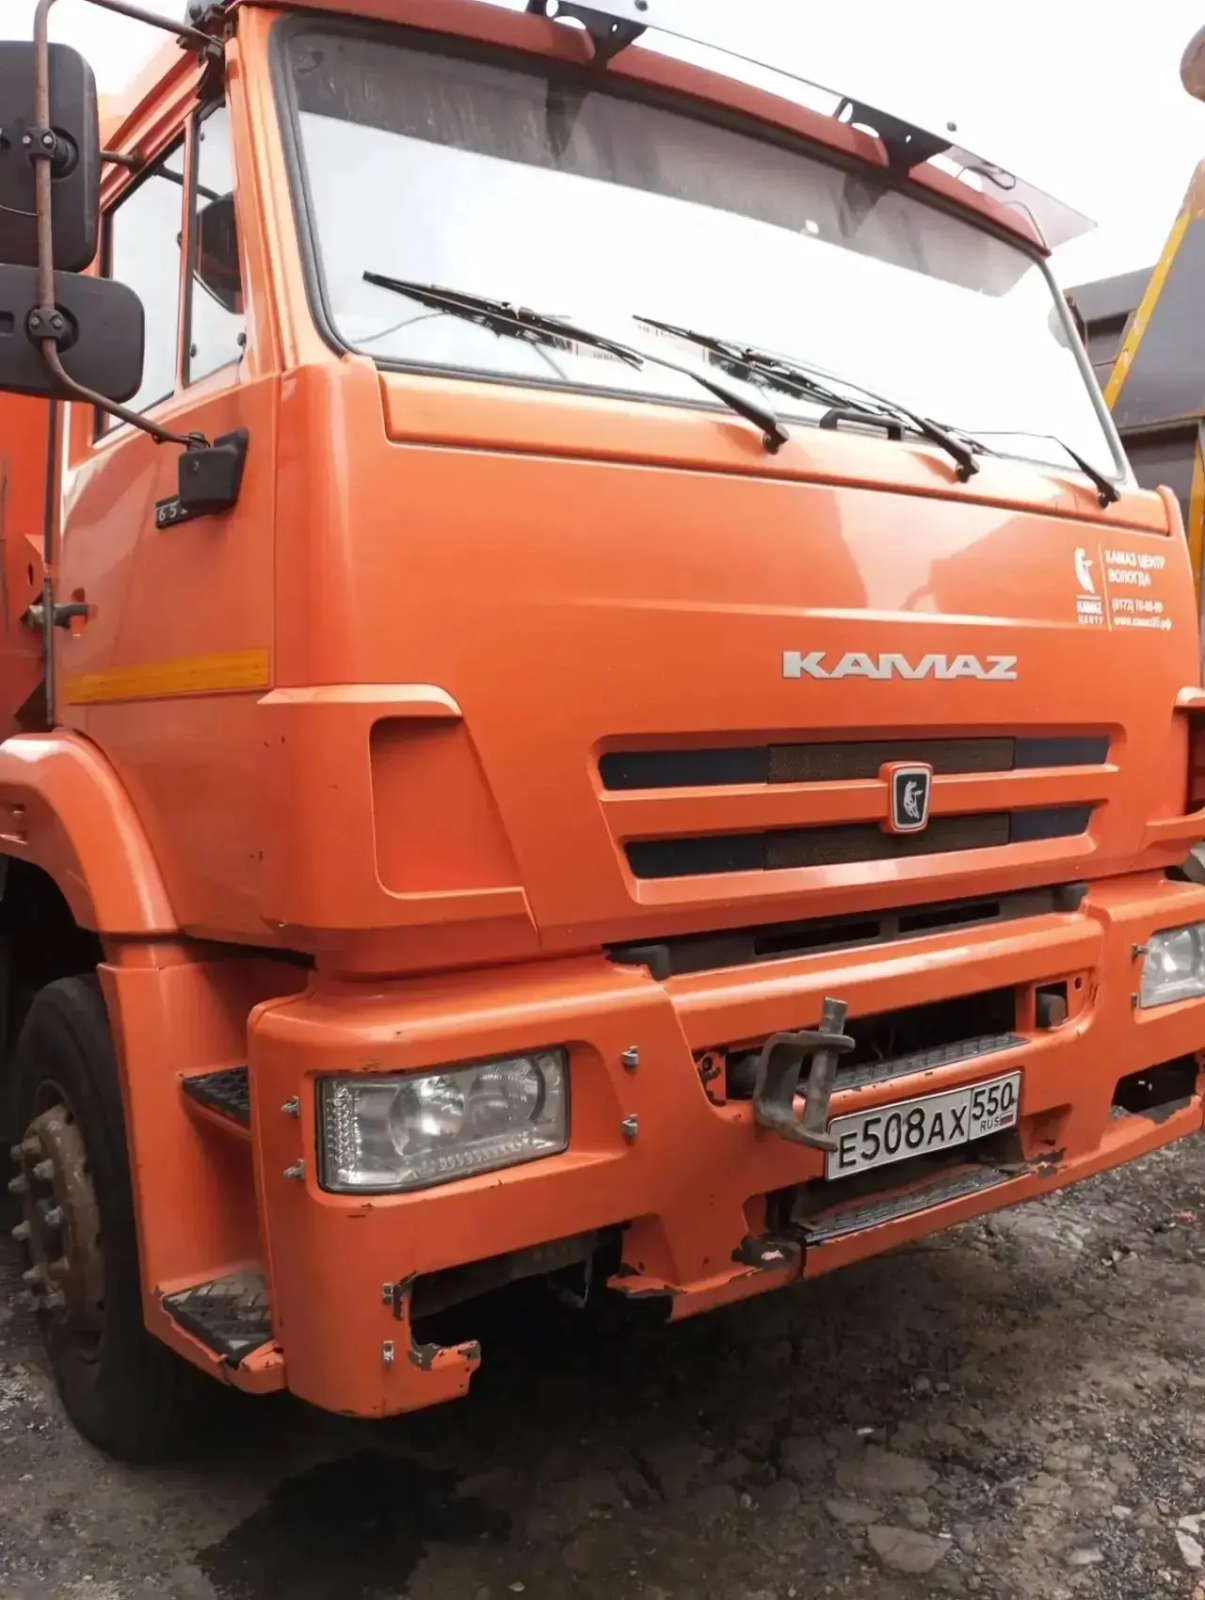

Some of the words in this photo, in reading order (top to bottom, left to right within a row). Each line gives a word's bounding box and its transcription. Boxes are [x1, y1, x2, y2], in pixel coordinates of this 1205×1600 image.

[1105, 550, 1137, 567] КАМАЗ
[1138, 554, 1166, 569] ЦЕНТР
[1108, 568, 1152, 588] ВОЛОГДА
[783, 651, 1017, 680] KAMAZ
[972, 1082, 1014, 1121] 550
[980, 1117, 1000, 1132] RUS
